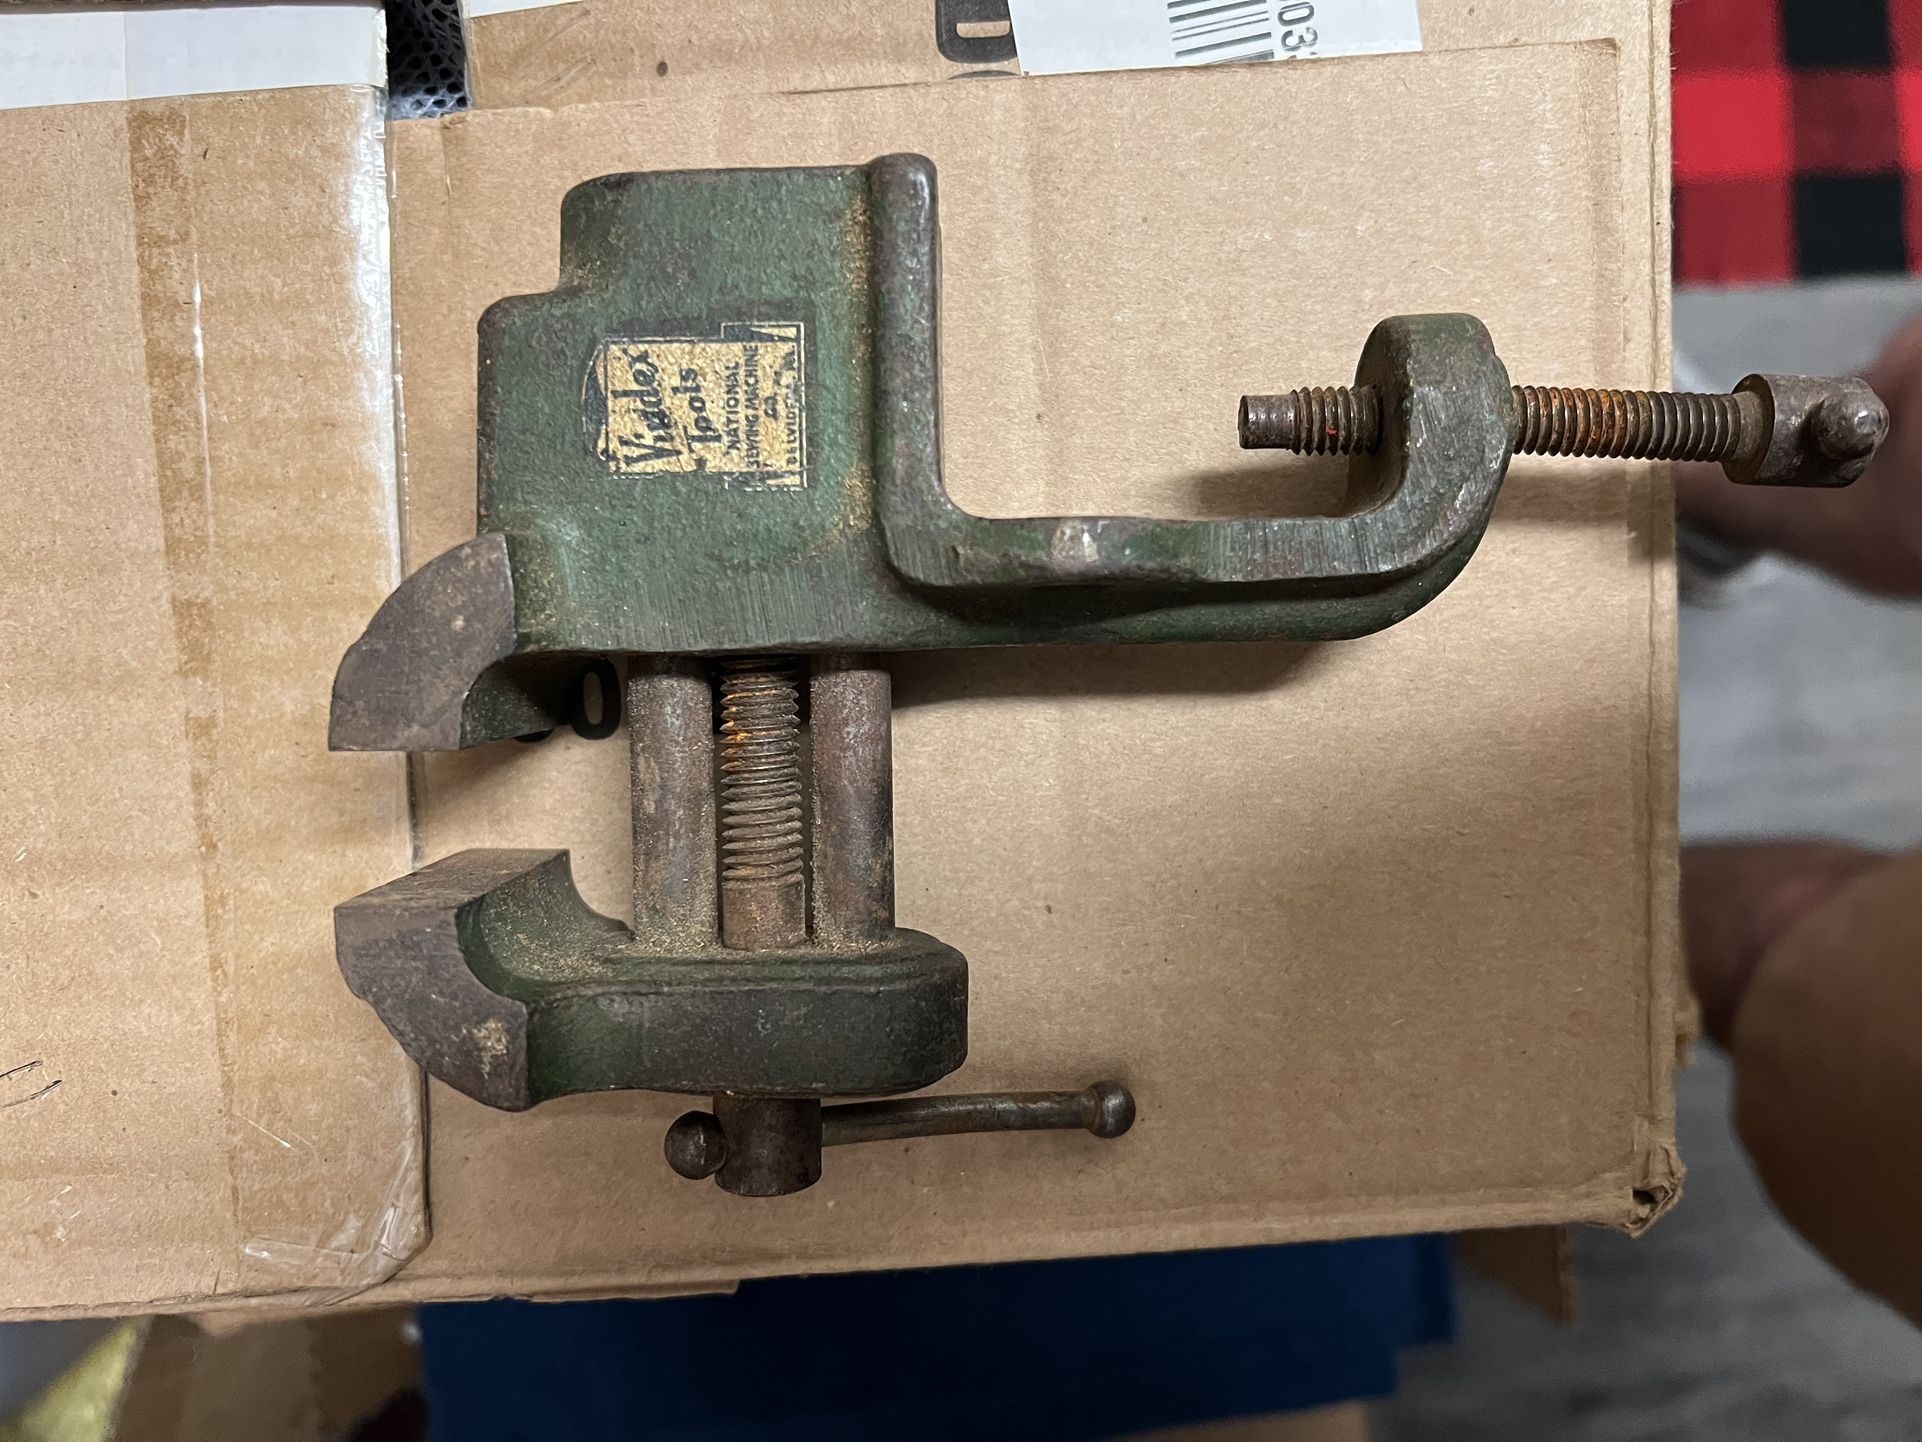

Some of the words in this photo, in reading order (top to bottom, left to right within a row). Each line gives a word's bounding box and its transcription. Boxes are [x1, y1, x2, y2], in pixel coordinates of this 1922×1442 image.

[611, 348, 682, 465] Vindex
[671, 367, 722, 453] Tools
[725, 362, 740, 450] NATIONAL
[743, 344, 759, 410] MACHINE
[745, 414, 760, 468] SEWING
